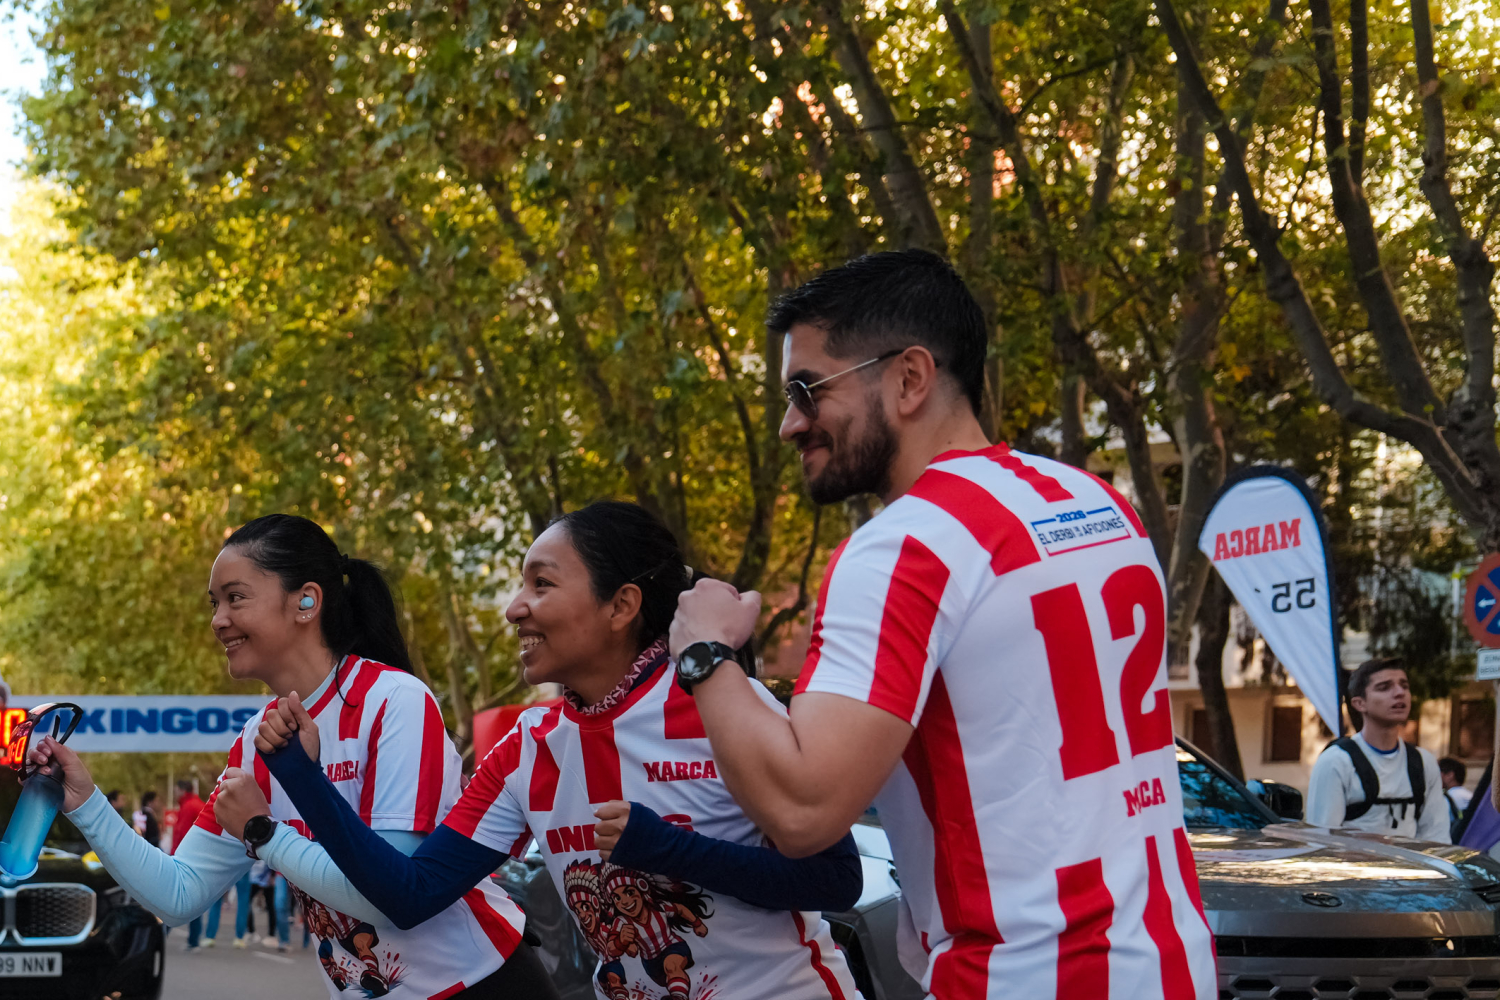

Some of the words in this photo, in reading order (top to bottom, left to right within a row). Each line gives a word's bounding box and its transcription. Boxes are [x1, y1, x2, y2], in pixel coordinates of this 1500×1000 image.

[1038, 532, 1051, 545] EL
[1049, 526, 1076, 542] DERBI
[1082, 516, 1125, 535] AFICIONES
[1030, 564, 1173, 781] 12
[643, 761, 717, 782] MARCA
